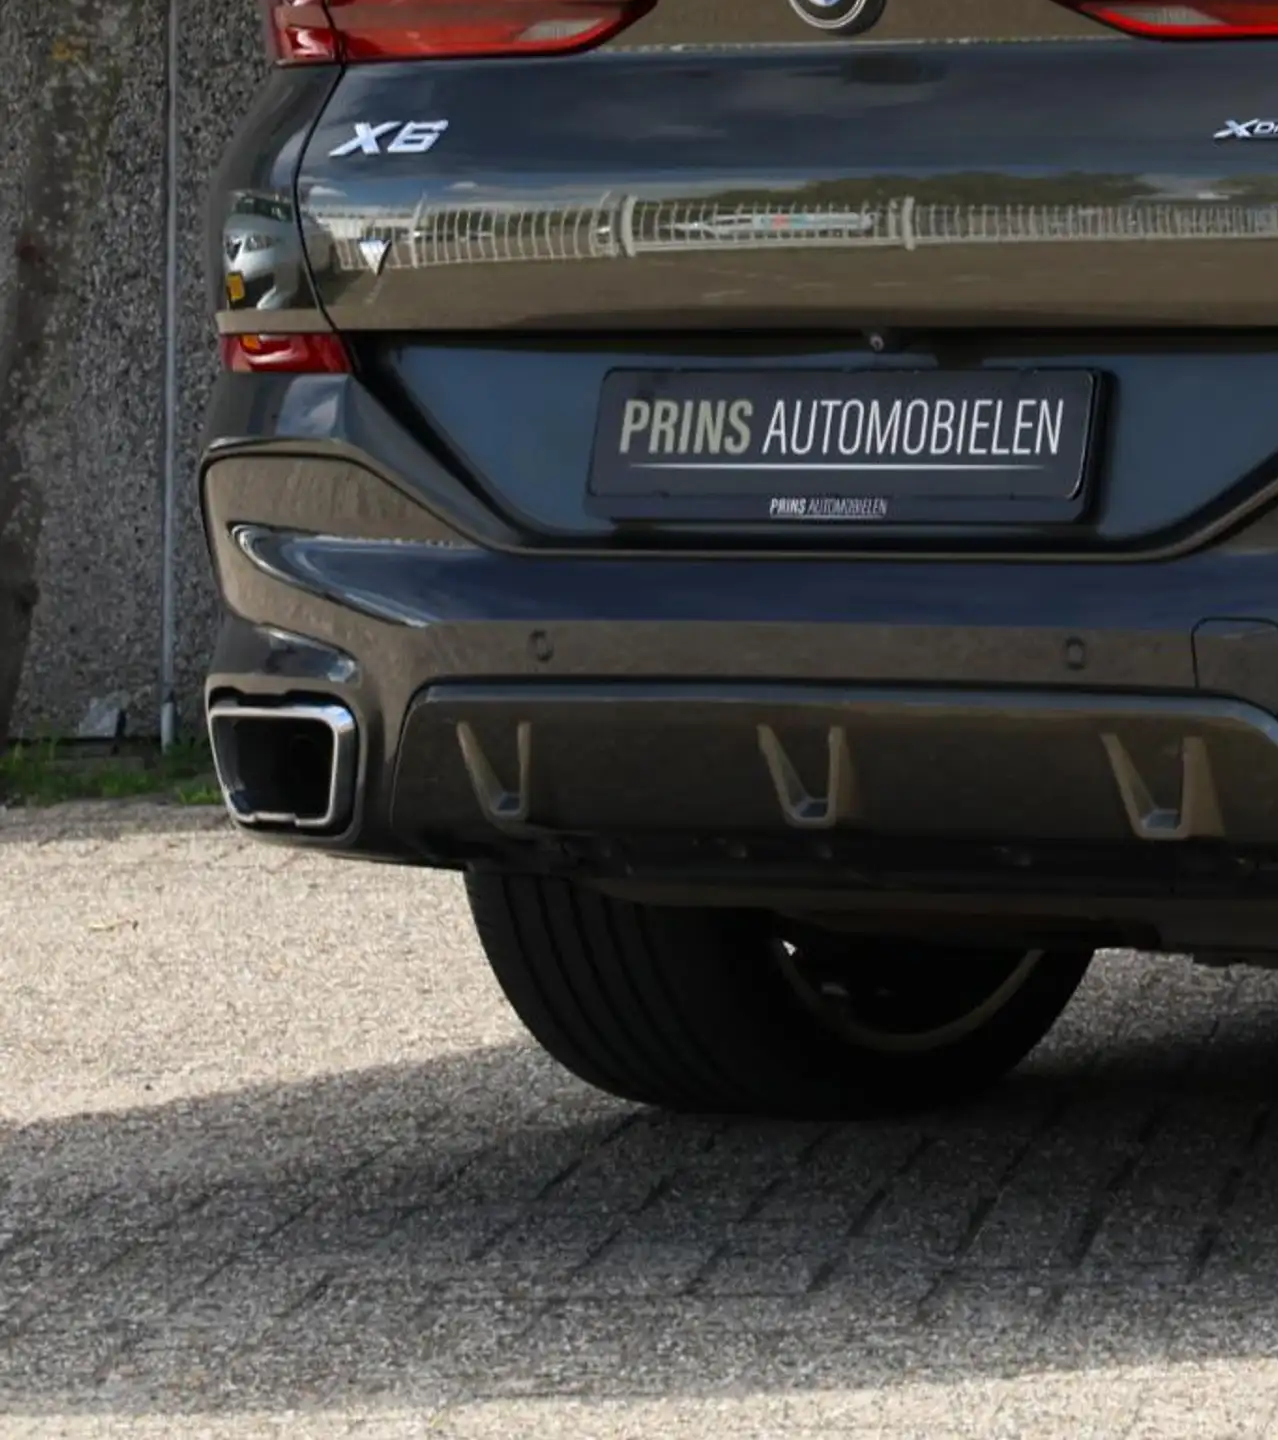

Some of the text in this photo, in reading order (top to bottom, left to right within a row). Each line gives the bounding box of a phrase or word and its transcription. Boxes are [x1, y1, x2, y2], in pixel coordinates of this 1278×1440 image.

[328, 119, 450, 157] X6
[619, 397, 1065, 457] PRINS AUTOMOBIELEN
[769, 496, 807, 516] PRINS
